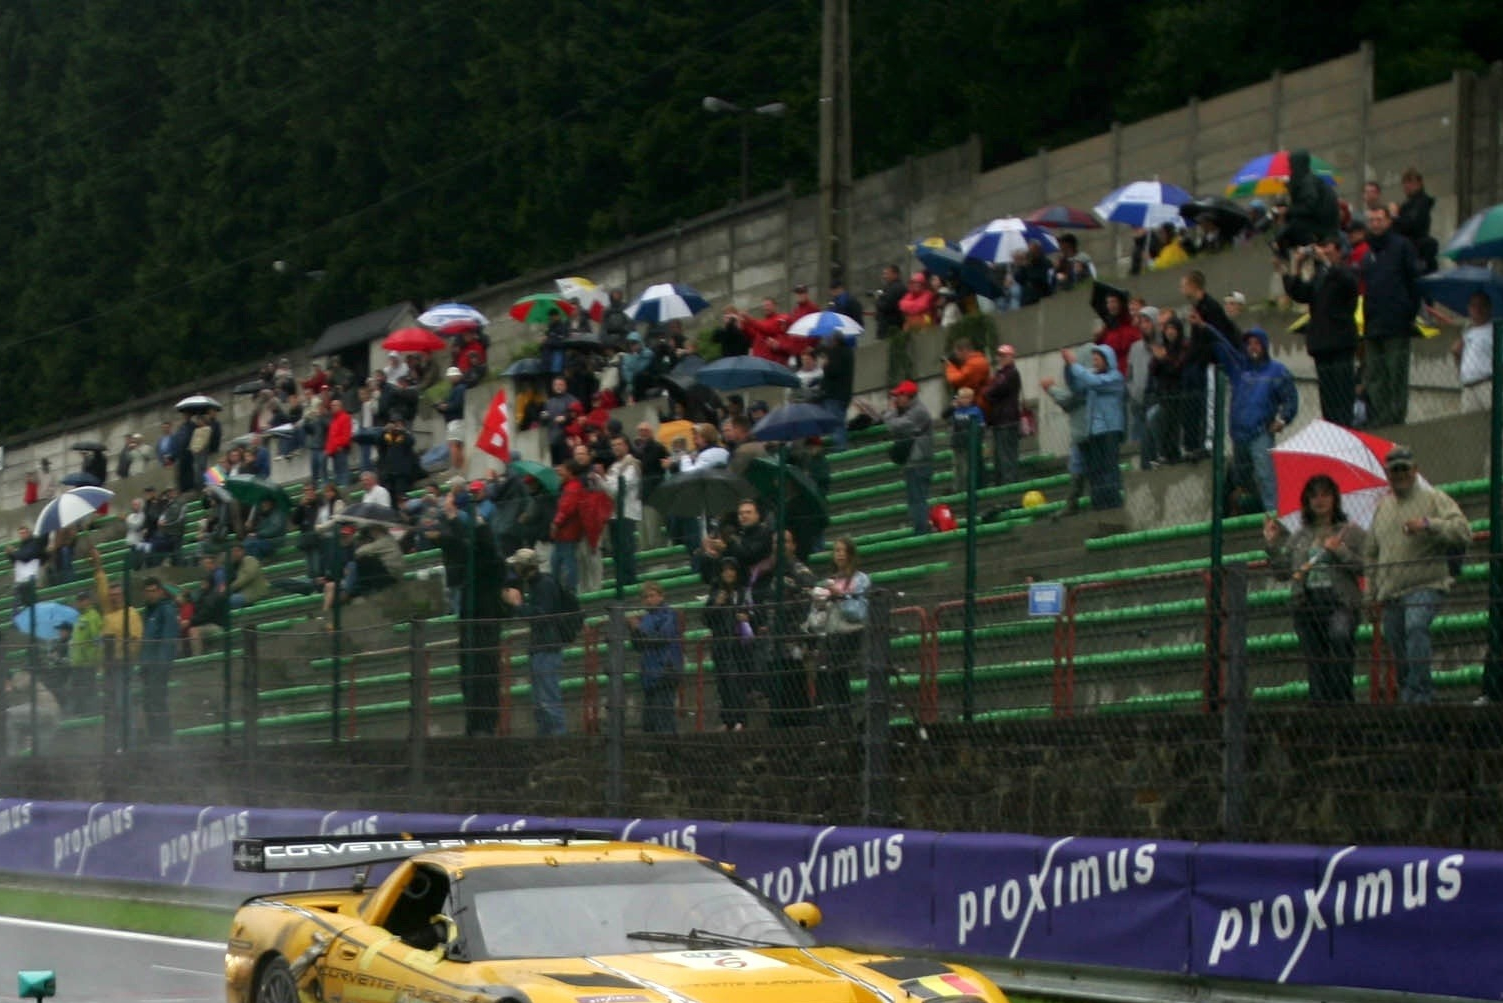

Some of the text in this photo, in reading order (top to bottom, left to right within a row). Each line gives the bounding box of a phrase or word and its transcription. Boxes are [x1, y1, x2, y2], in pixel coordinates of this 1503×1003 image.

[53, 802, 136, 877] proximus
[159, 806, 250, 886] proximus
[957, 836, 1158, 959] proximus
[1207, 845, 1465, 984] proximus
